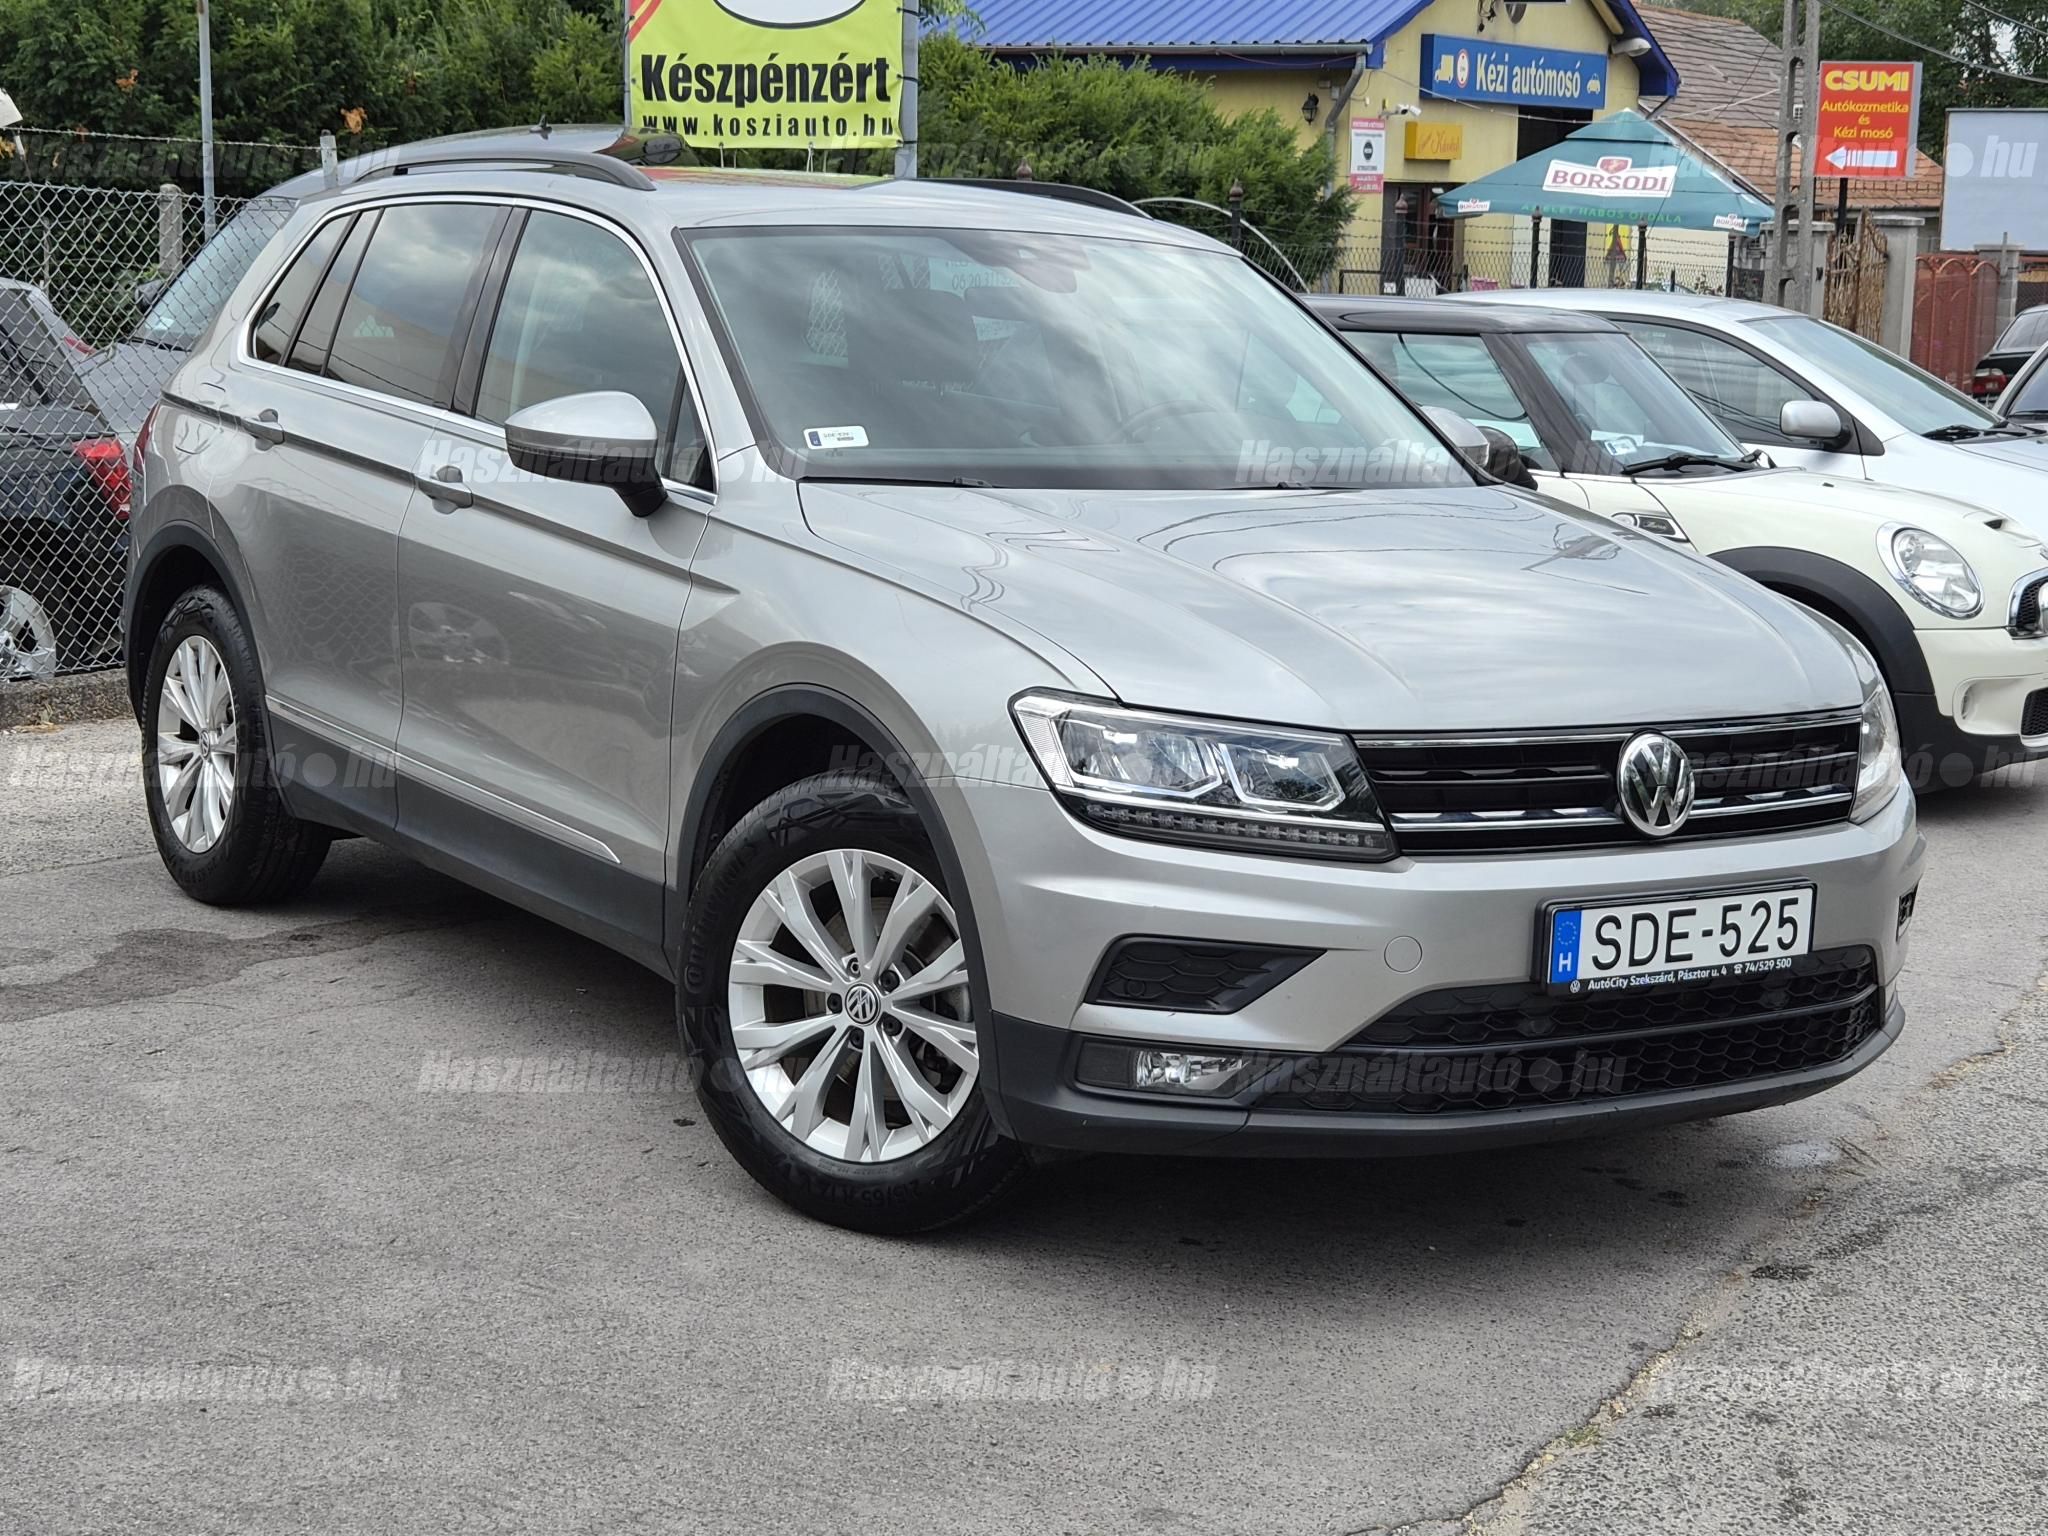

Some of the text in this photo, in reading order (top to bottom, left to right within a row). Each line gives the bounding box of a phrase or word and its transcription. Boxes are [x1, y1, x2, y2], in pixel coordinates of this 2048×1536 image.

[641, 53, 891, 108] Készpénzért
[1475, 51, 1581, 98] Kézi autómosó
[1825, 71, 1909, 91] CSUMI
[1821, 100, 1909, 113] Autókozmetika
[1858, 114, 1870, 125] és
[1833, 126, 1893, 138] Kézi mosó
[1551, 170, 1668, 192] BORSODI
[1591, 897, 1799, 971] SDE-525
[1558, 952, 1572, 973] H
[1587, 957, 1792, 991] AutóCity Szekszárd, Pásztor u. 4 74/529 500
